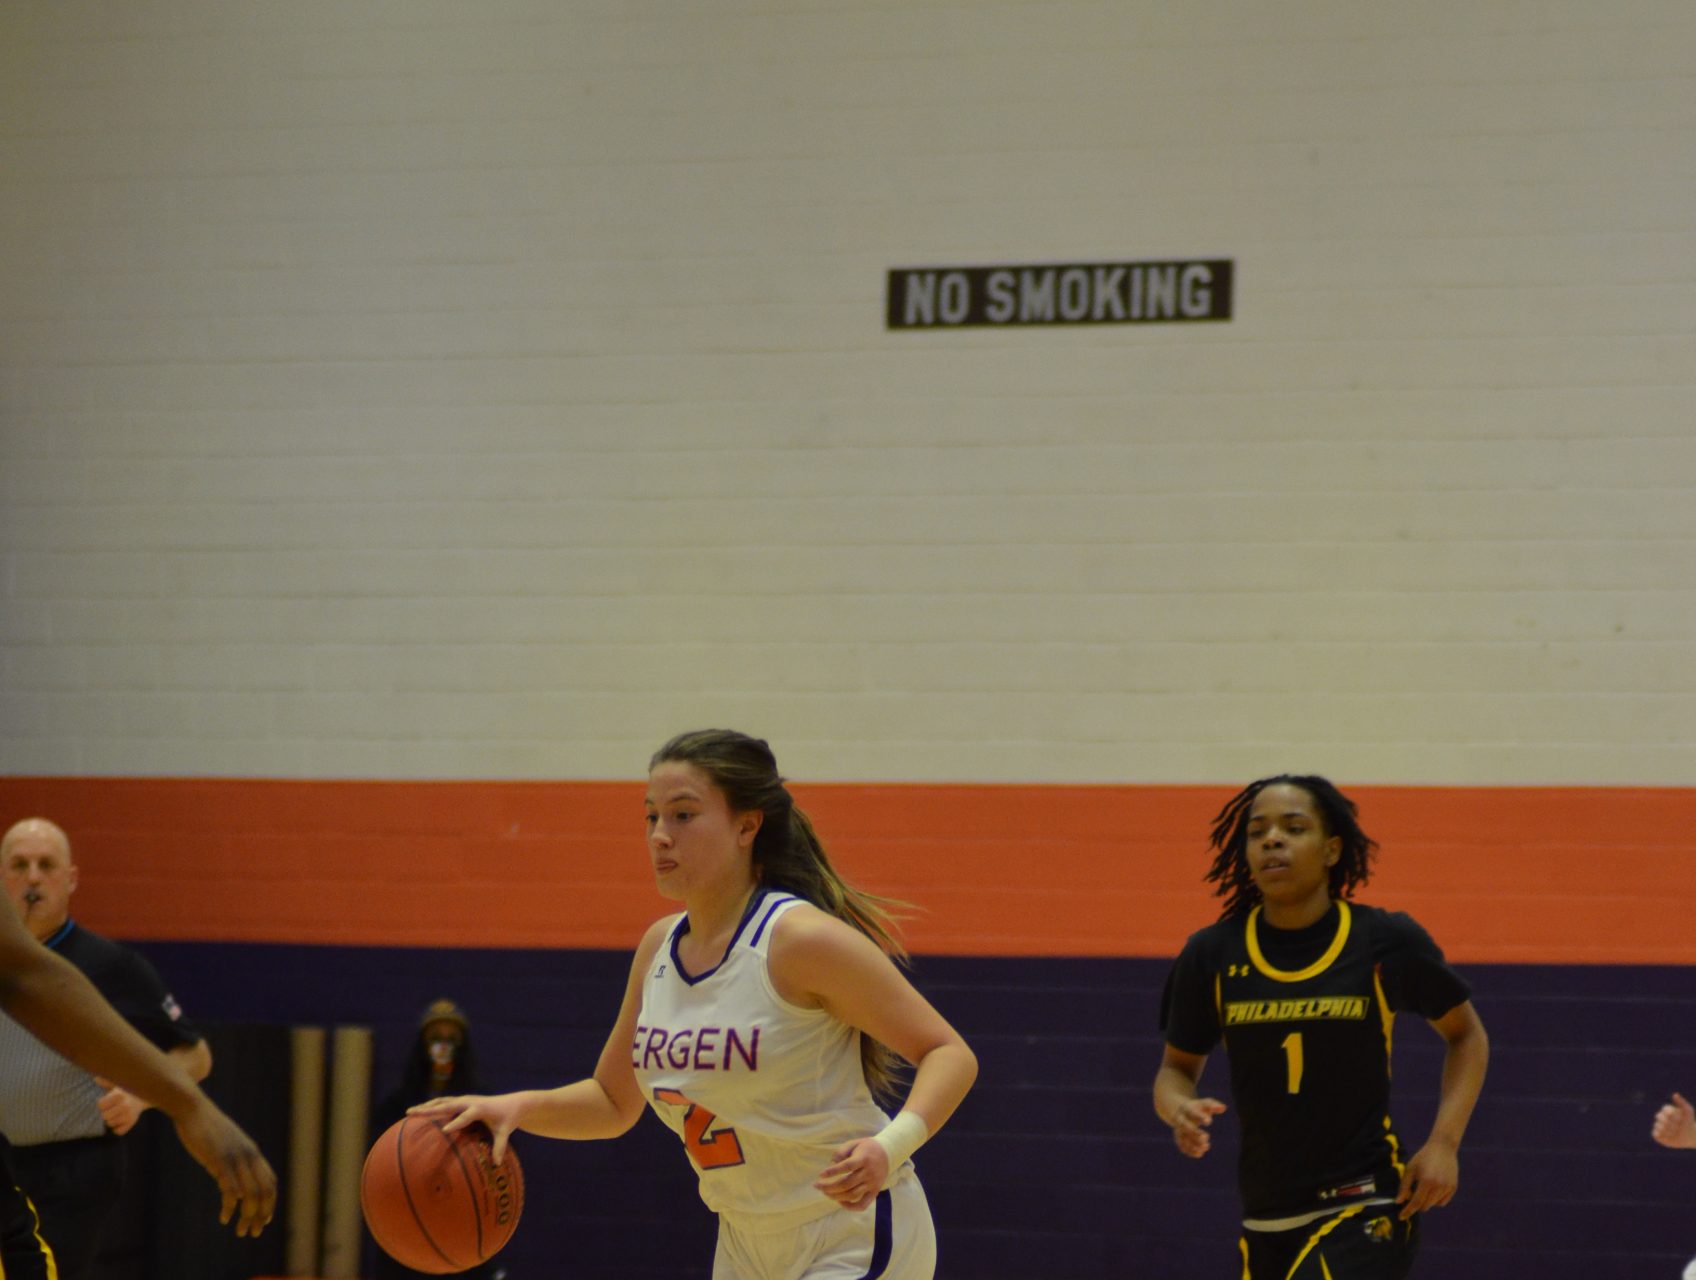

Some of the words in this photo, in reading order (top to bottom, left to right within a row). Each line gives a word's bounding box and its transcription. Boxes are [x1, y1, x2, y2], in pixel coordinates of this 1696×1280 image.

[903, 271, 970, 325] NO
[984, 263, 1214, 323] SMOKING
[1226, 998, 1366, 1024] PHILADELPHIA
[631, 1025, 761, 1072] ERGEN
[1281, 1032, 1304, 1095] 1
[653, 1086, 746, 1171] 2
